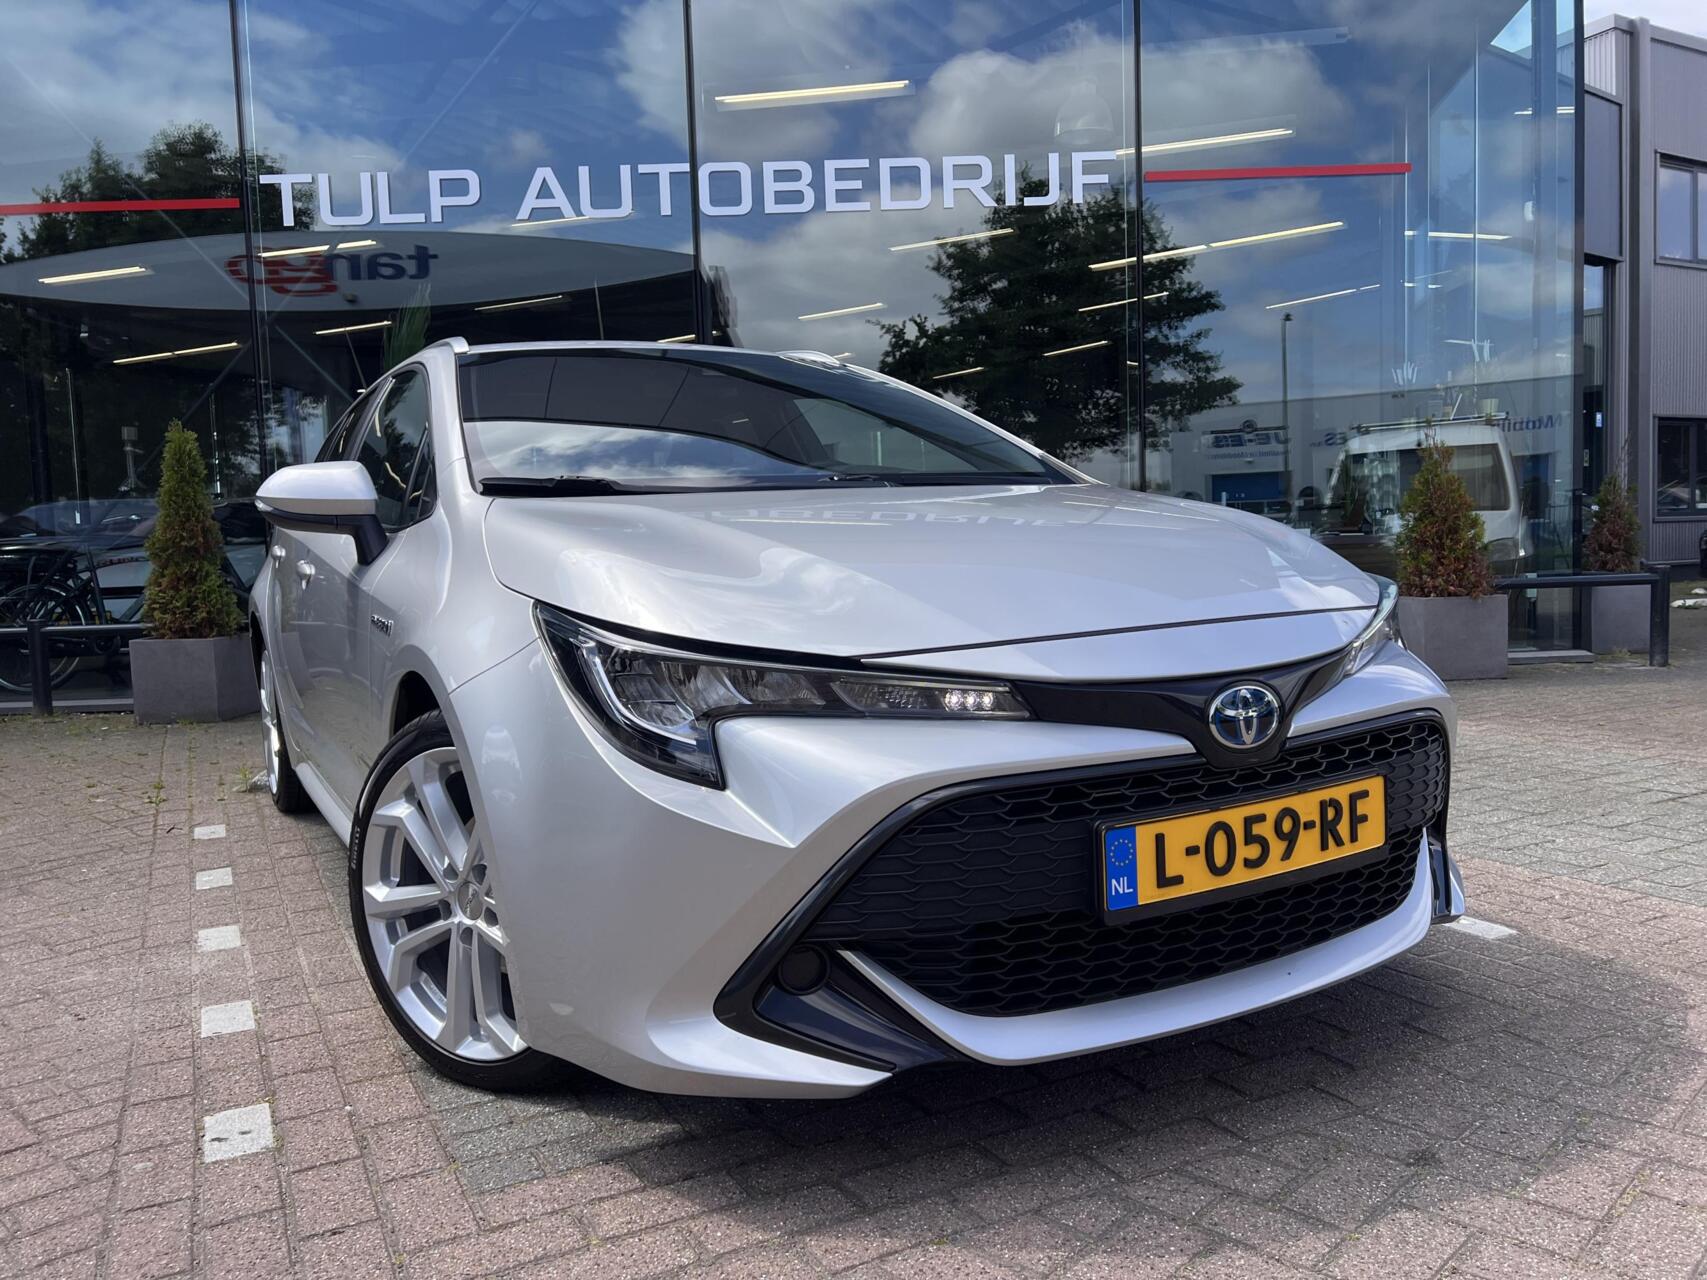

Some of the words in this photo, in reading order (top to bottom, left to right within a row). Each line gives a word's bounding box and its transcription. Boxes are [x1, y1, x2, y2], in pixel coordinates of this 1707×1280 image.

[259, 169, 480, 227] TULP
[516, 151, 1117, 220] AUTOBEDRIJF
[1155, 789, 1370, 889] L-059-RF
[1111, 876, 1134, 896] NL
